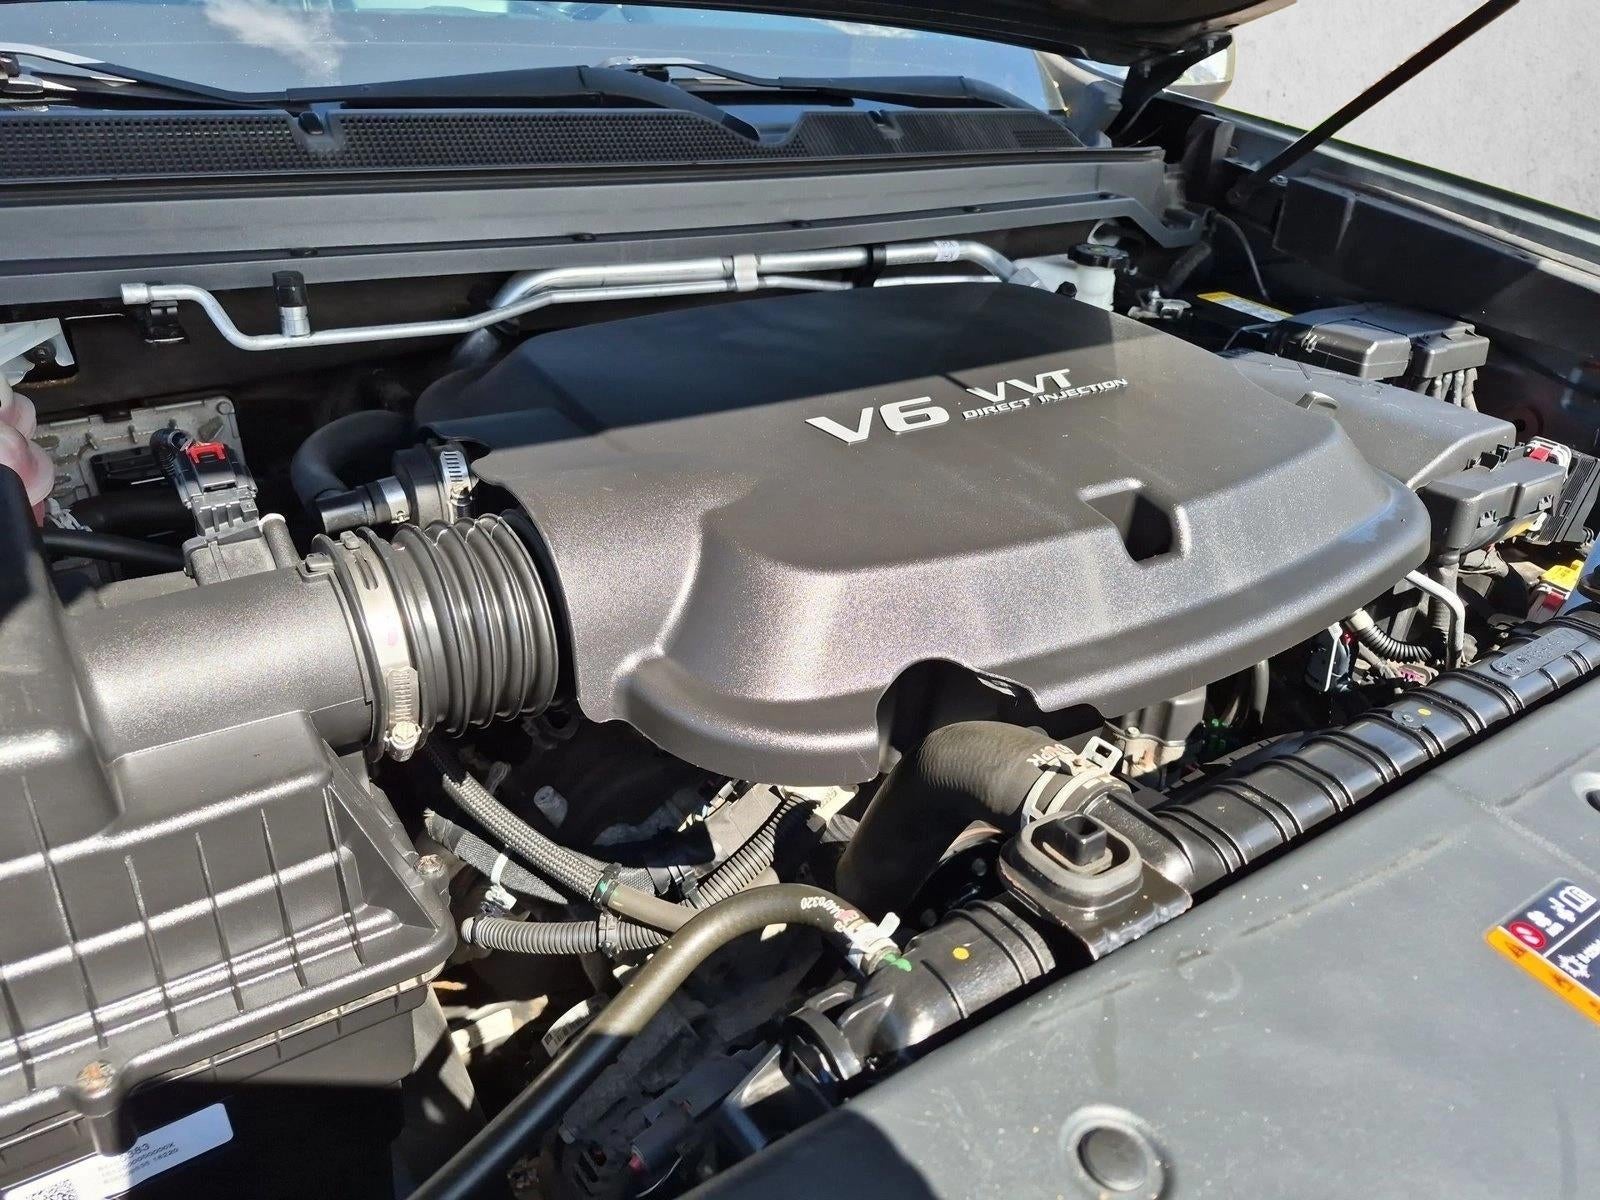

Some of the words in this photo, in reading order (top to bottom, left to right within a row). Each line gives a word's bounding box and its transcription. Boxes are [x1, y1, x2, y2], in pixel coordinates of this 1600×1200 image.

[805, 396, 950, 445] V6
[966, 368, 1070, 404] VVT
[962, 398, 1031, 421] DIRECT
[1038, 378, 1129, 405] INJECTION
